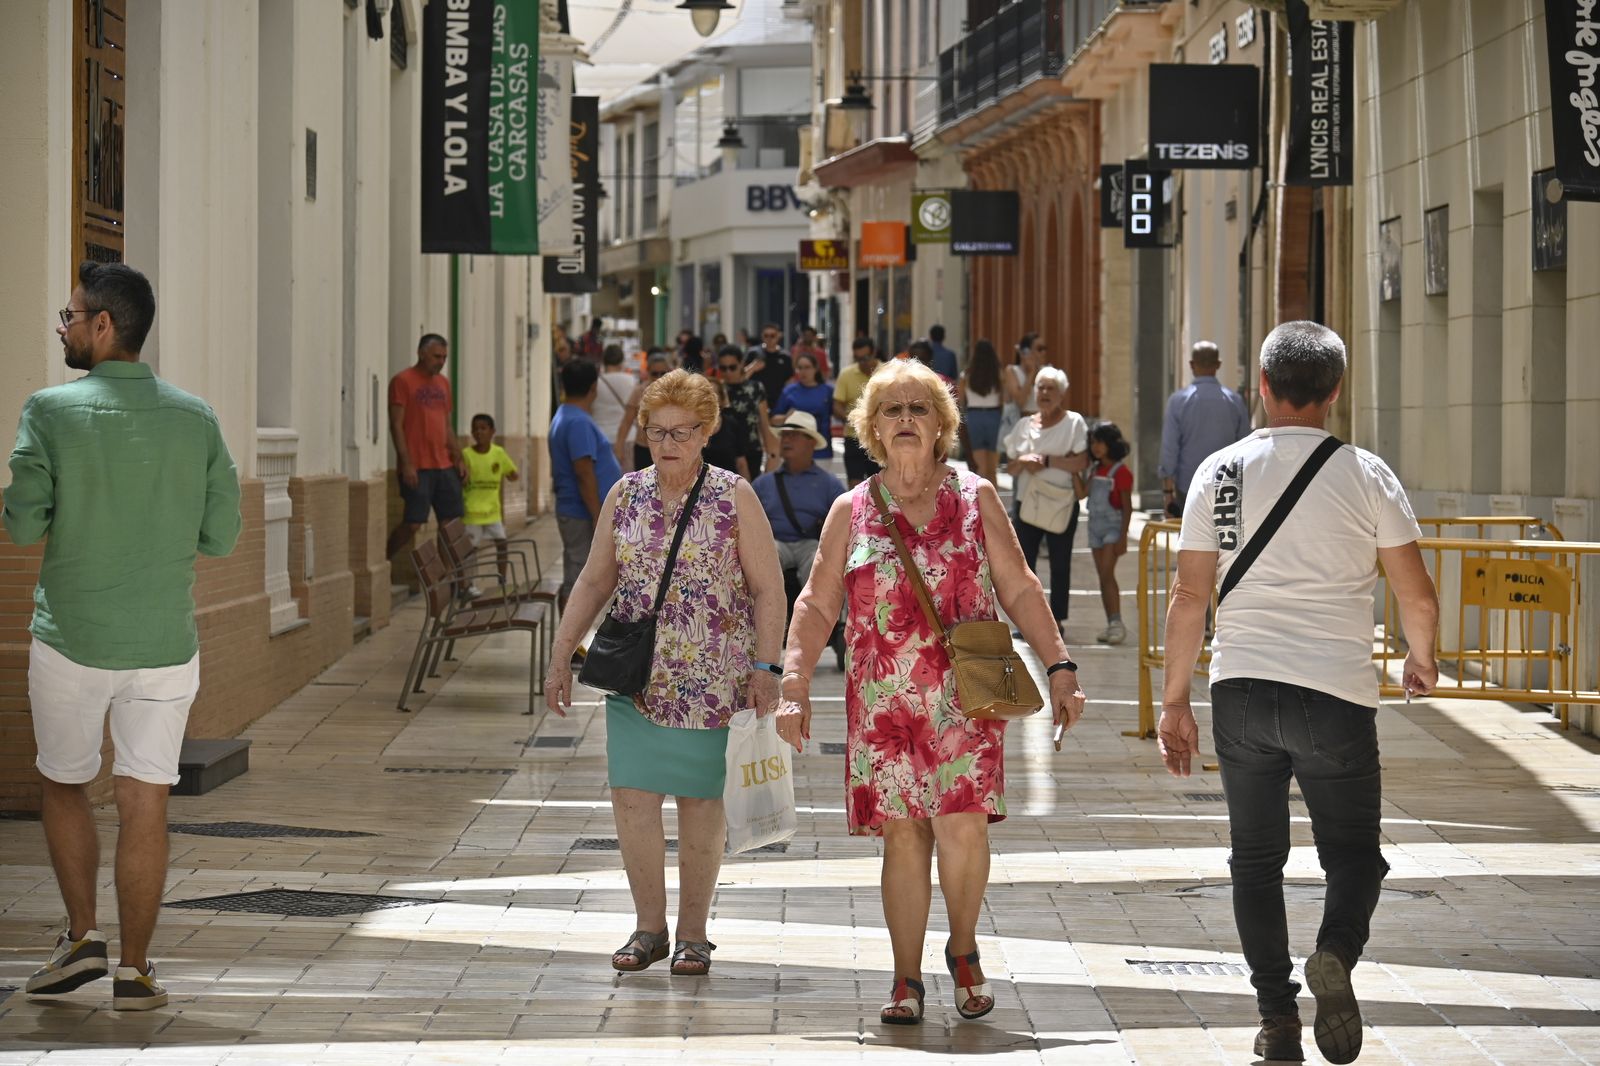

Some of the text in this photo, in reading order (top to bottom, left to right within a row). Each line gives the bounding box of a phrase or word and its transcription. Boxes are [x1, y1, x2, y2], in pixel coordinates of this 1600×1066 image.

[444, 0, 470, 196] BIMBA Y LOLA
[488, 4, 506, 218] LA CASA DE LAS
[508, 43, 529, 181] CARCASAS
[1310, 64, 1329, 113] REAL
[1310, 118, 1329, 178] LYNCIS
[1505, 573, 1545, 586] POLICIA
[1508, 591, 1542, 604] LOCAL
